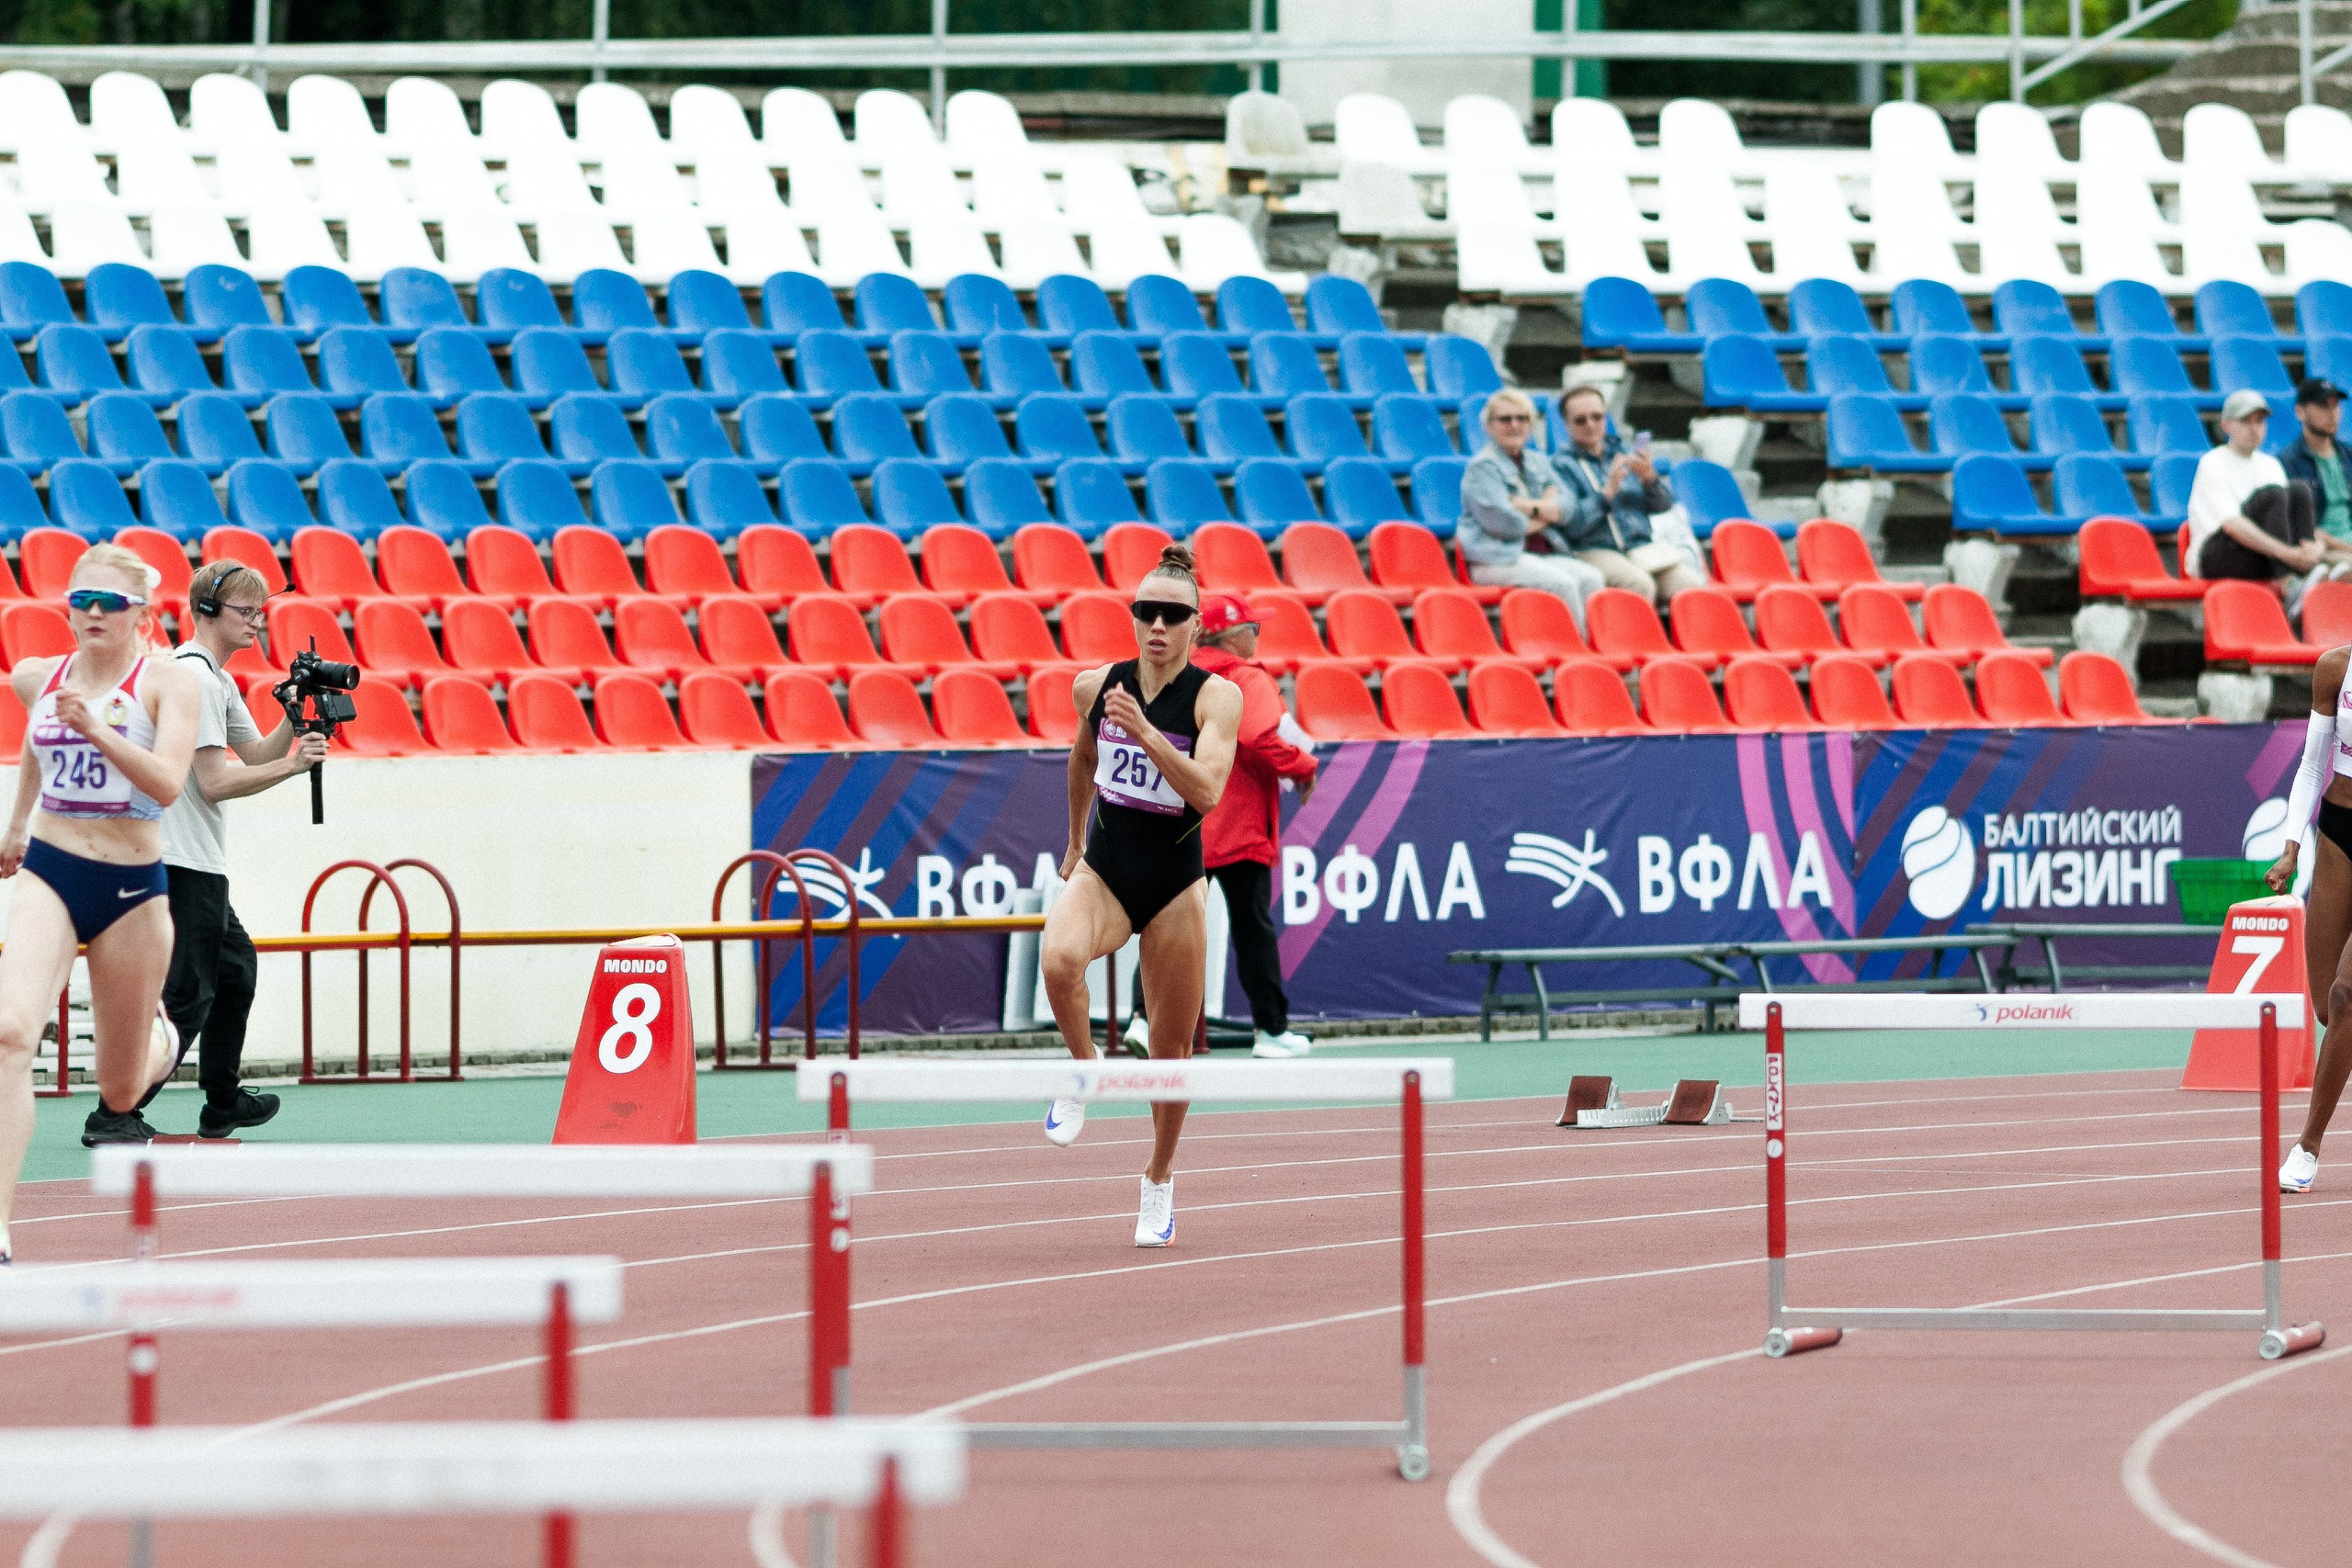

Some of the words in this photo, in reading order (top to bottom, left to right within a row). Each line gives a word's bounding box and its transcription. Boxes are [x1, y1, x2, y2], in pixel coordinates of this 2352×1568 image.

[52, 750, 107, 789] 245
[1984, 805, 2182, 847] БАЛТИЙСКИЙ
[917, 852, 1064, 919] ВФ
[1282, 840, 1486, 925] ВФЛА
[1638, 830, 1833, 912] ВФЛА
[1981, 848, 2182, 910] ЛИЗИНГ
[2232, 917, 2290, 931] MONDO
[604, 959, 668, 974] MONDO
[2231, 935, 2284, 994] 7
[598, 982, 662, 1074] 8
[1996, 1003, 2073, 1024] polanik
